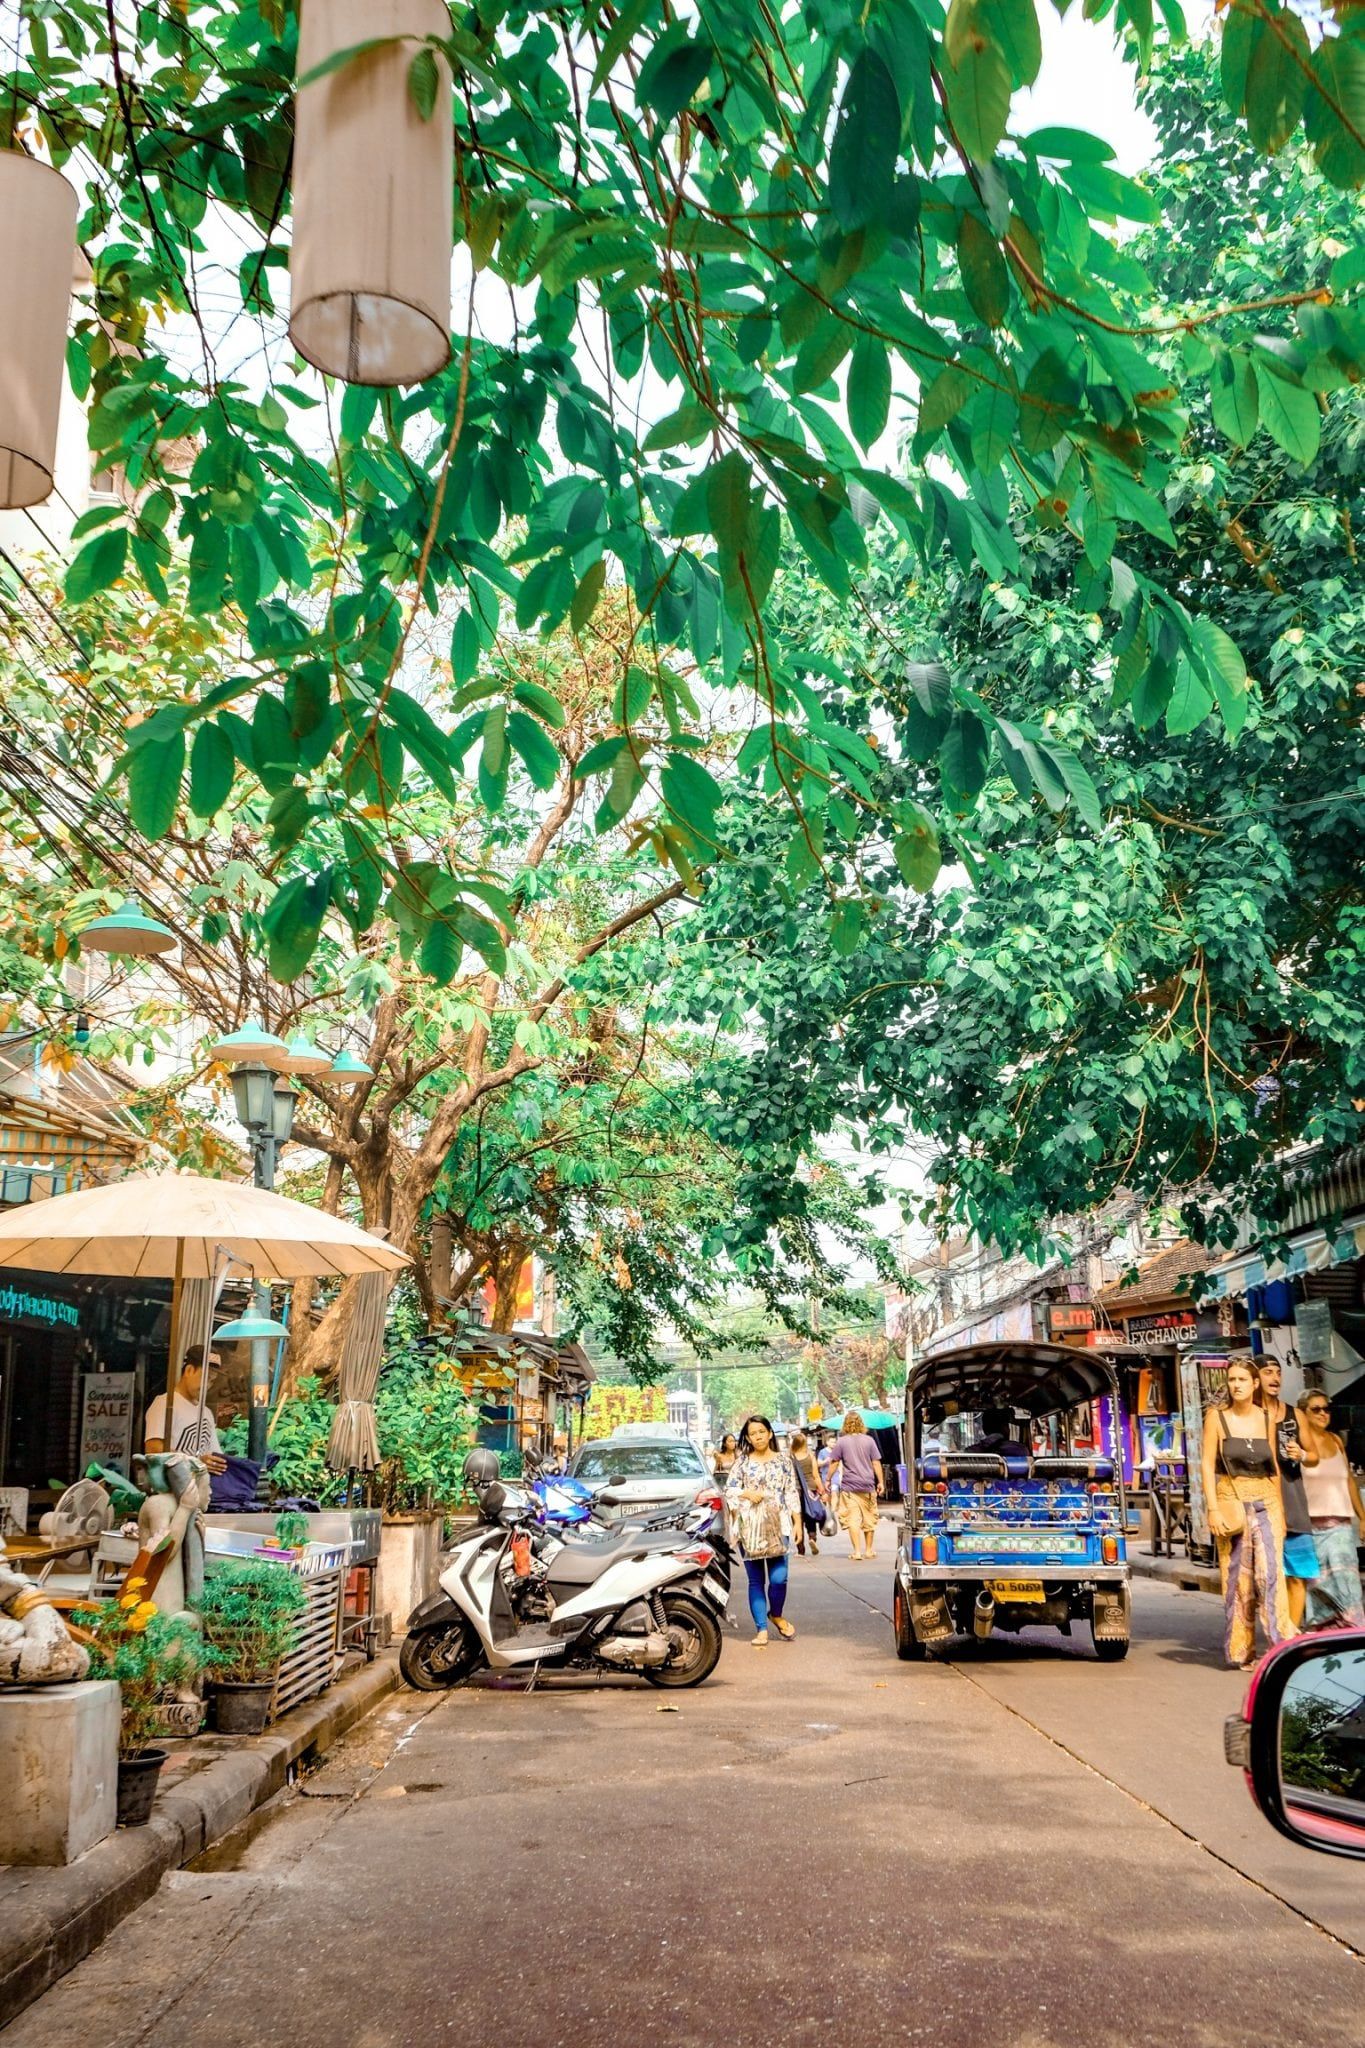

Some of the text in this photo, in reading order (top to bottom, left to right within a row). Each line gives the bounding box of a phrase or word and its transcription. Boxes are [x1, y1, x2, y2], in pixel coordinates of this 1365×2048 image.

[1130, 1324, 1198, 1346] EXCHANGE
[87, 1403, 129, 1417] SALE
[84, 1442, 125, 1453] 50-70%
[108, 1452, 123, 1460] OFF
